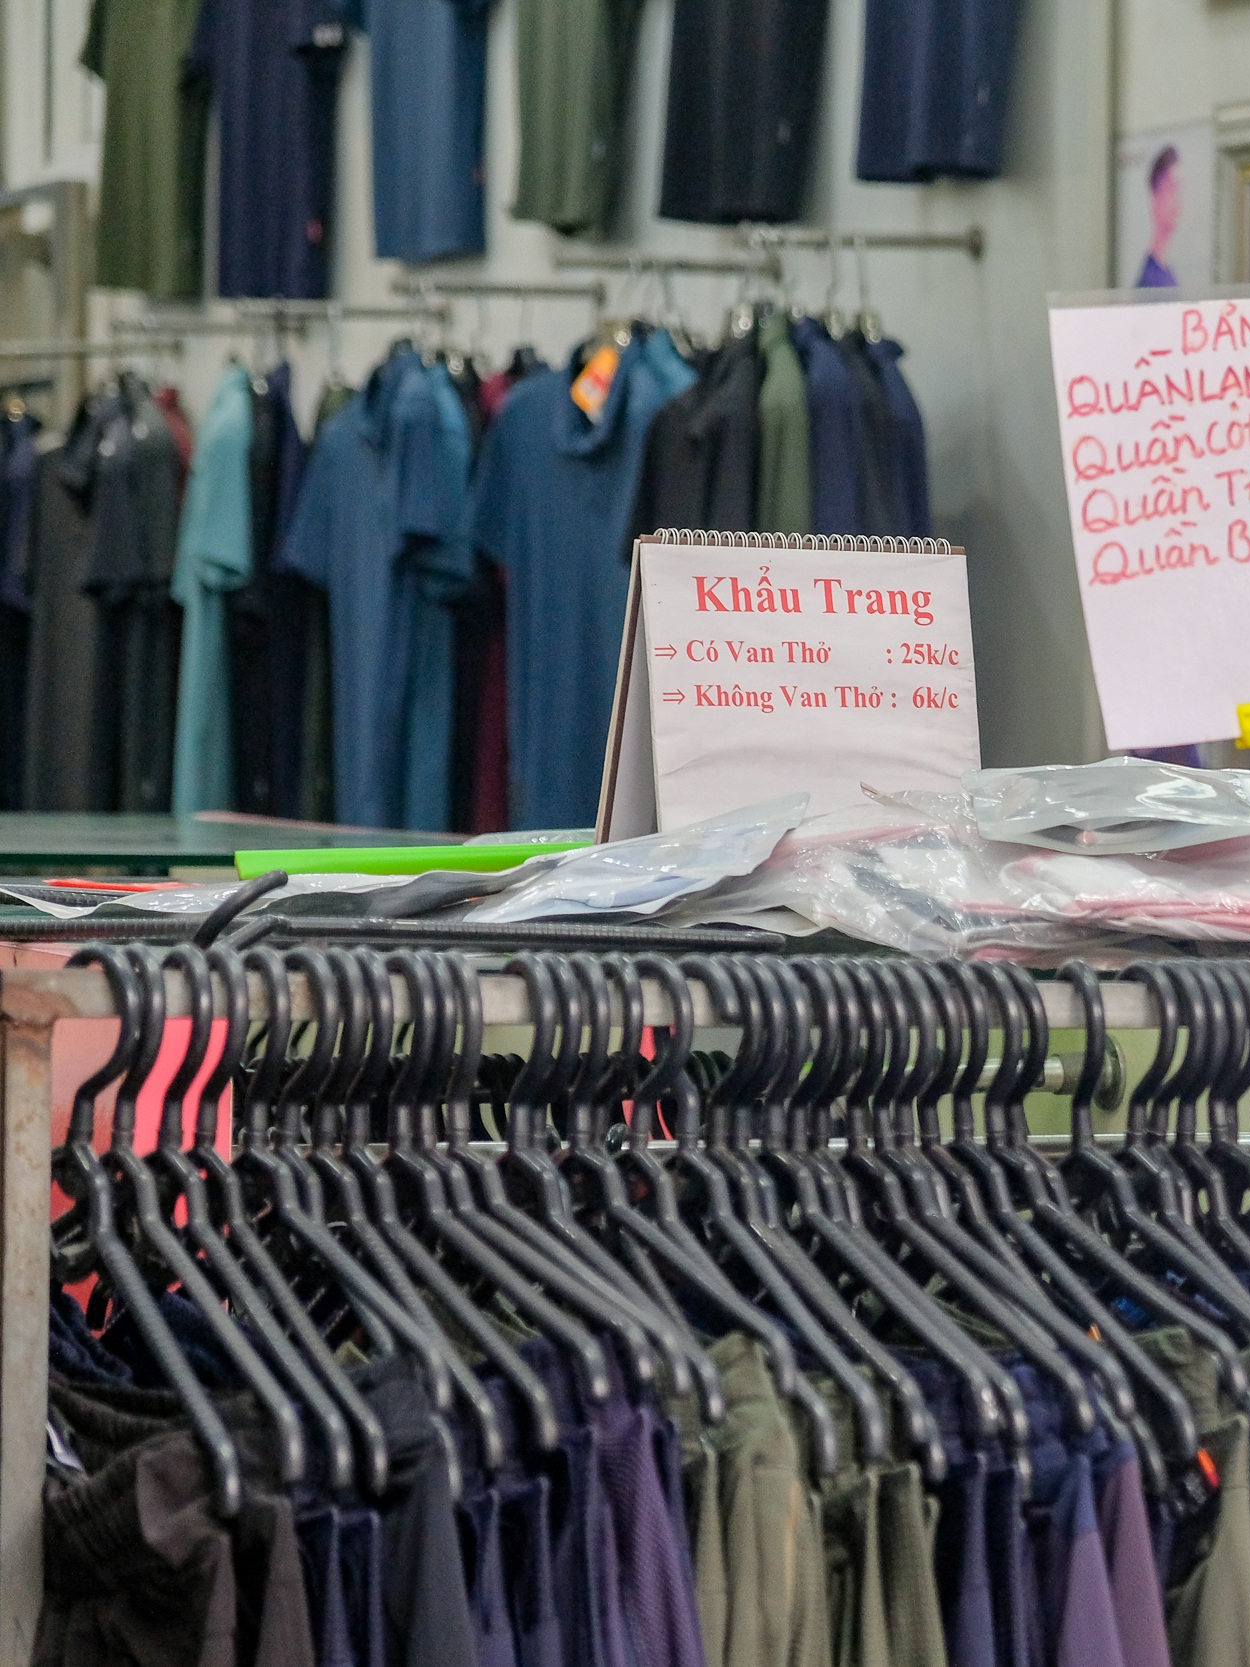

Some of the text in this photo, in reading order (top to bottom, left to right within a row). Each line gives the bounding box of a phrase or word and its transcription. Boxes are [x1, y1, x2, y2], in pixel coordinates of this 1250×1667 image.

[1072, 414, 1205, 485] Quần
[1082, 467, 1211, 533] Quần
[1089, 521, 1220, 586] Quần
[691, 565, 934, 626] Khẩu Trang
[686, 639, 719, 664] Có
[725, 640, 775, 664] Van
[781, 640, 832, 665] Thở
[901, 643, 960, 667] 25k/c
[694, 684, 773, 714] Không
[779, 684, 828, 709] Van
[834, 685, 885, 710] Thở
[911, 686, 959, 710] 6k/c
